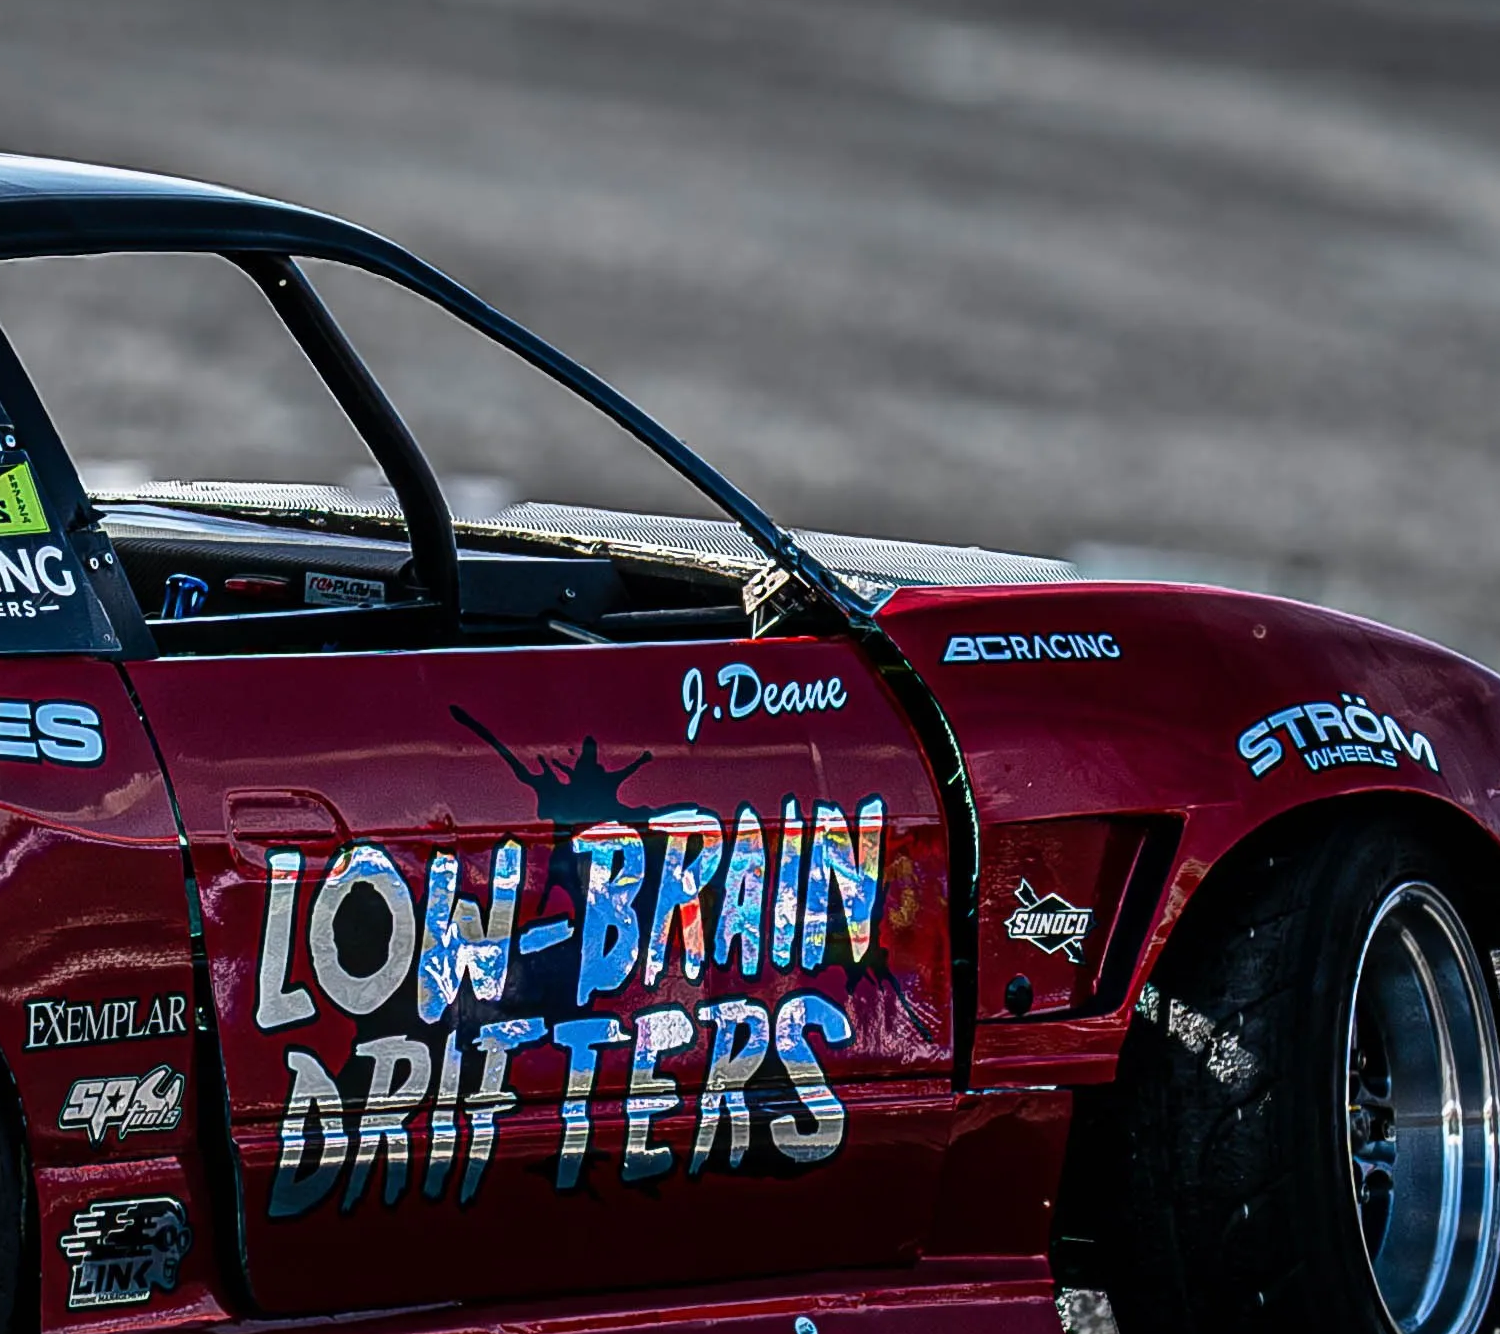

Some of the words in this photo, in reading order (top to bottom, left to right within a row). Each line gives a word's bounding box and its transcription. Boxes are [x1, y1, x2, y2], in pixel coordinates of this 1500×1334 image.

[1239, 693, 1439, 777] STRÖM
[1304, 745, 1397, 771] WHEELS
[1013, 913, 1089, 935] SUNOCO
[25, 996, 187, 1049] EXEMPLAR
[63, 1080, 137, 1139] SP
[121, 1101, 180, 1132] tools
[267, 995, 852, 1217] DRIFTERS
[73, 1258, 153, 1295] LINK
